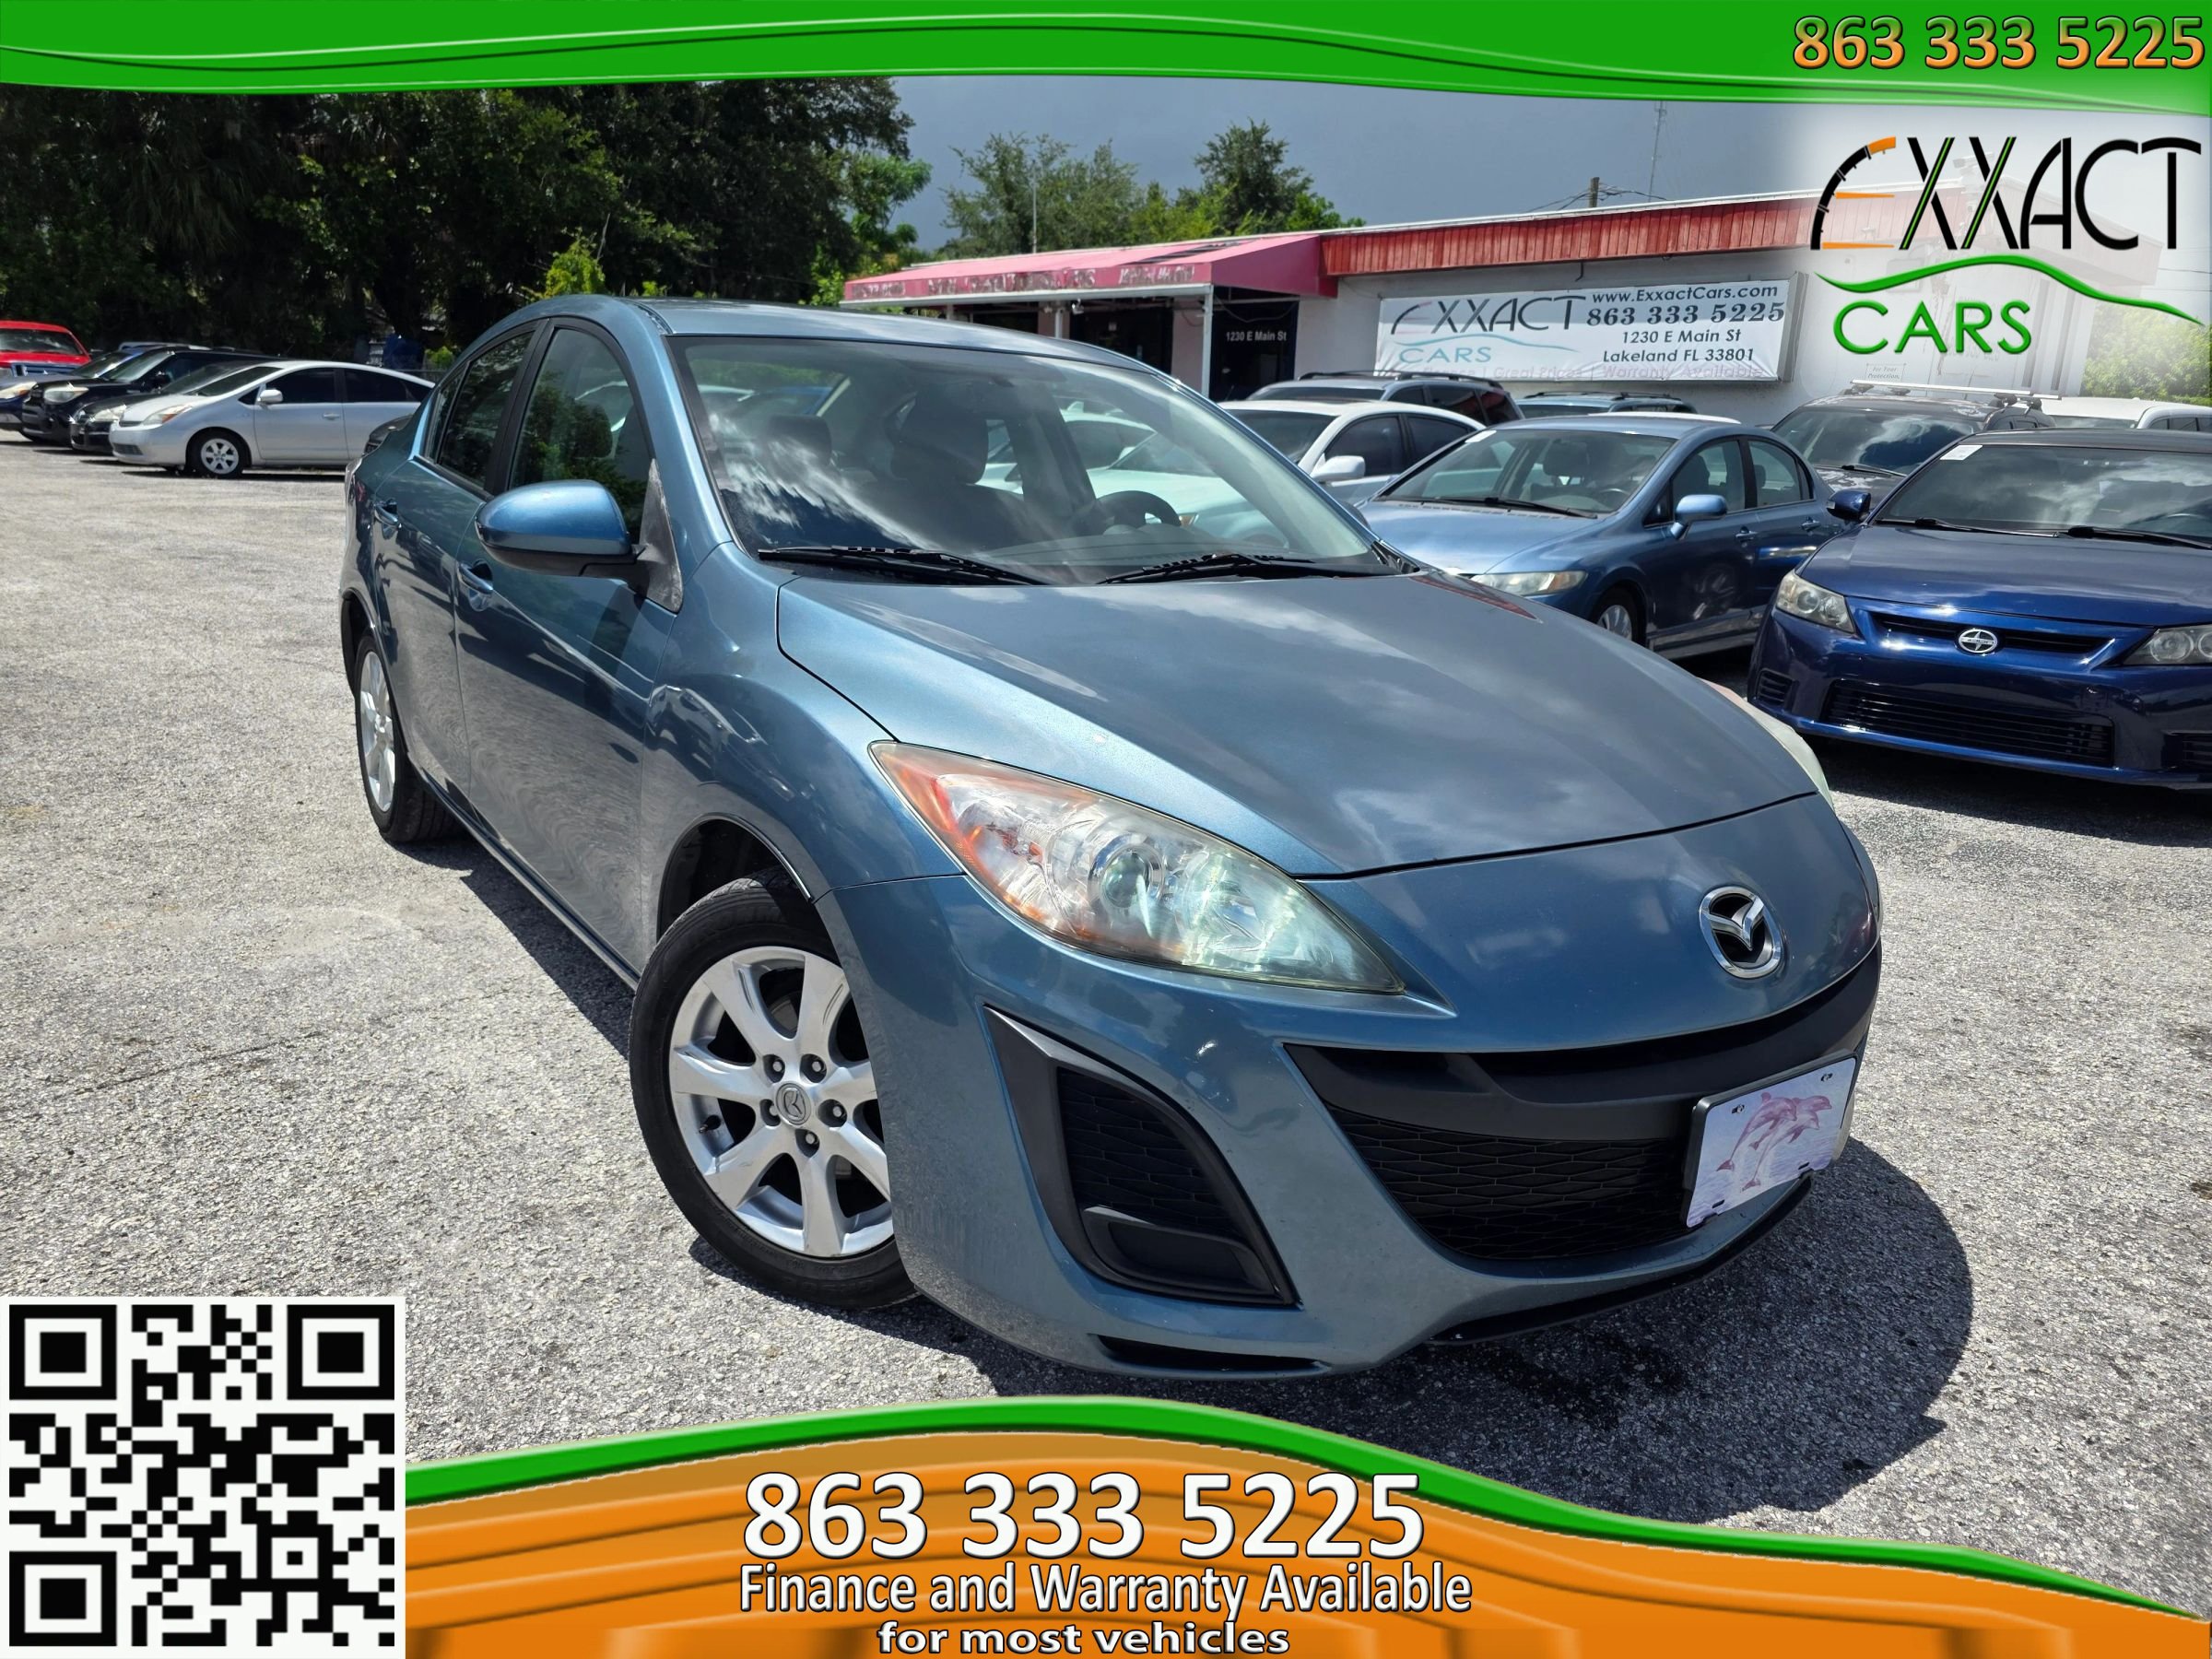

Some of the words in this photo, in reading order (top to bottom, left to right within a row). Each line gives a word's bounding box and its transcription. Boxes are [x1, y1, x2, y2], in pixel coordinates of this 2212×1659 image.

[1592, 286, 1778, 303] www.ExxactCars.com
[1390, 295, 1586, 335] EXXACT
[1586, 307, 1636, 326] 863
[1646, 304, 1699, 324] 333
[1710, 301, 1785, 324] 5225
[1226, 331, 1245, 341] 1230
[1246, 331, 1253, 341] E
[1254, 330, 1276, 341] Main
[1277, 330, 1287, 341] St
[1622, 331, 1659, 344] 1230
[1664, 331, 1674, 343] E
[1677, 329, 1720, 343] Main
[1725, 329, 1741, 342] St
[1399, 346, 1492, 364] CARS
[1603, 349, 1677, 363] Lakeland
[1683, 349, 1700, 361] FL
[1705, 348, 1754, 361] 33801
